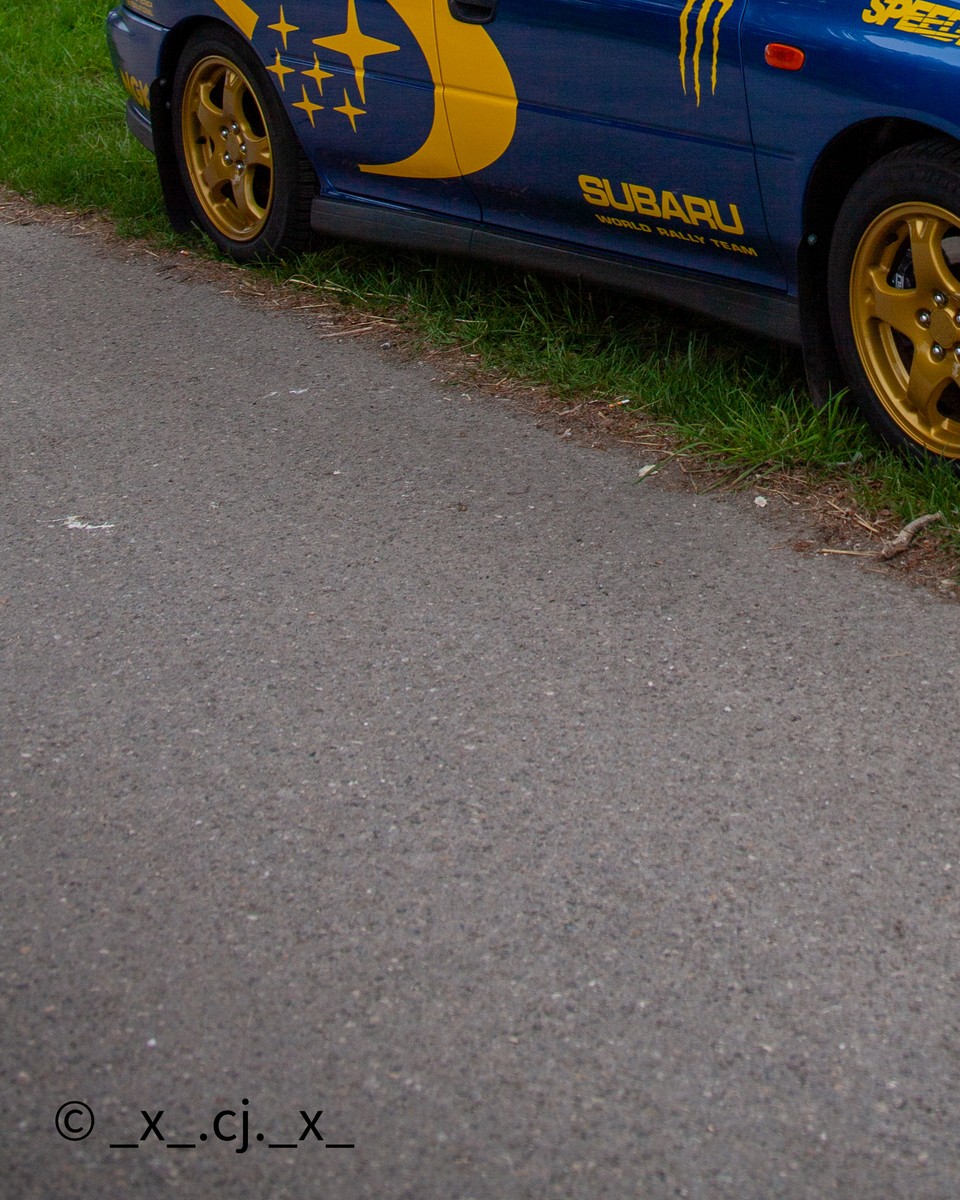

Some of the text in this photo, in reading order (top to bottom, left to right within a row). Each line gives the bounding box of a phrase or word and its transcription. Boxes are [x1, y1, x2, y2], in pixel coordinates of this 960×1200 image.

[577, 174, 745, 236] SUBARU
[594, 213, 759, 257] WORLD RALLY TEAM
